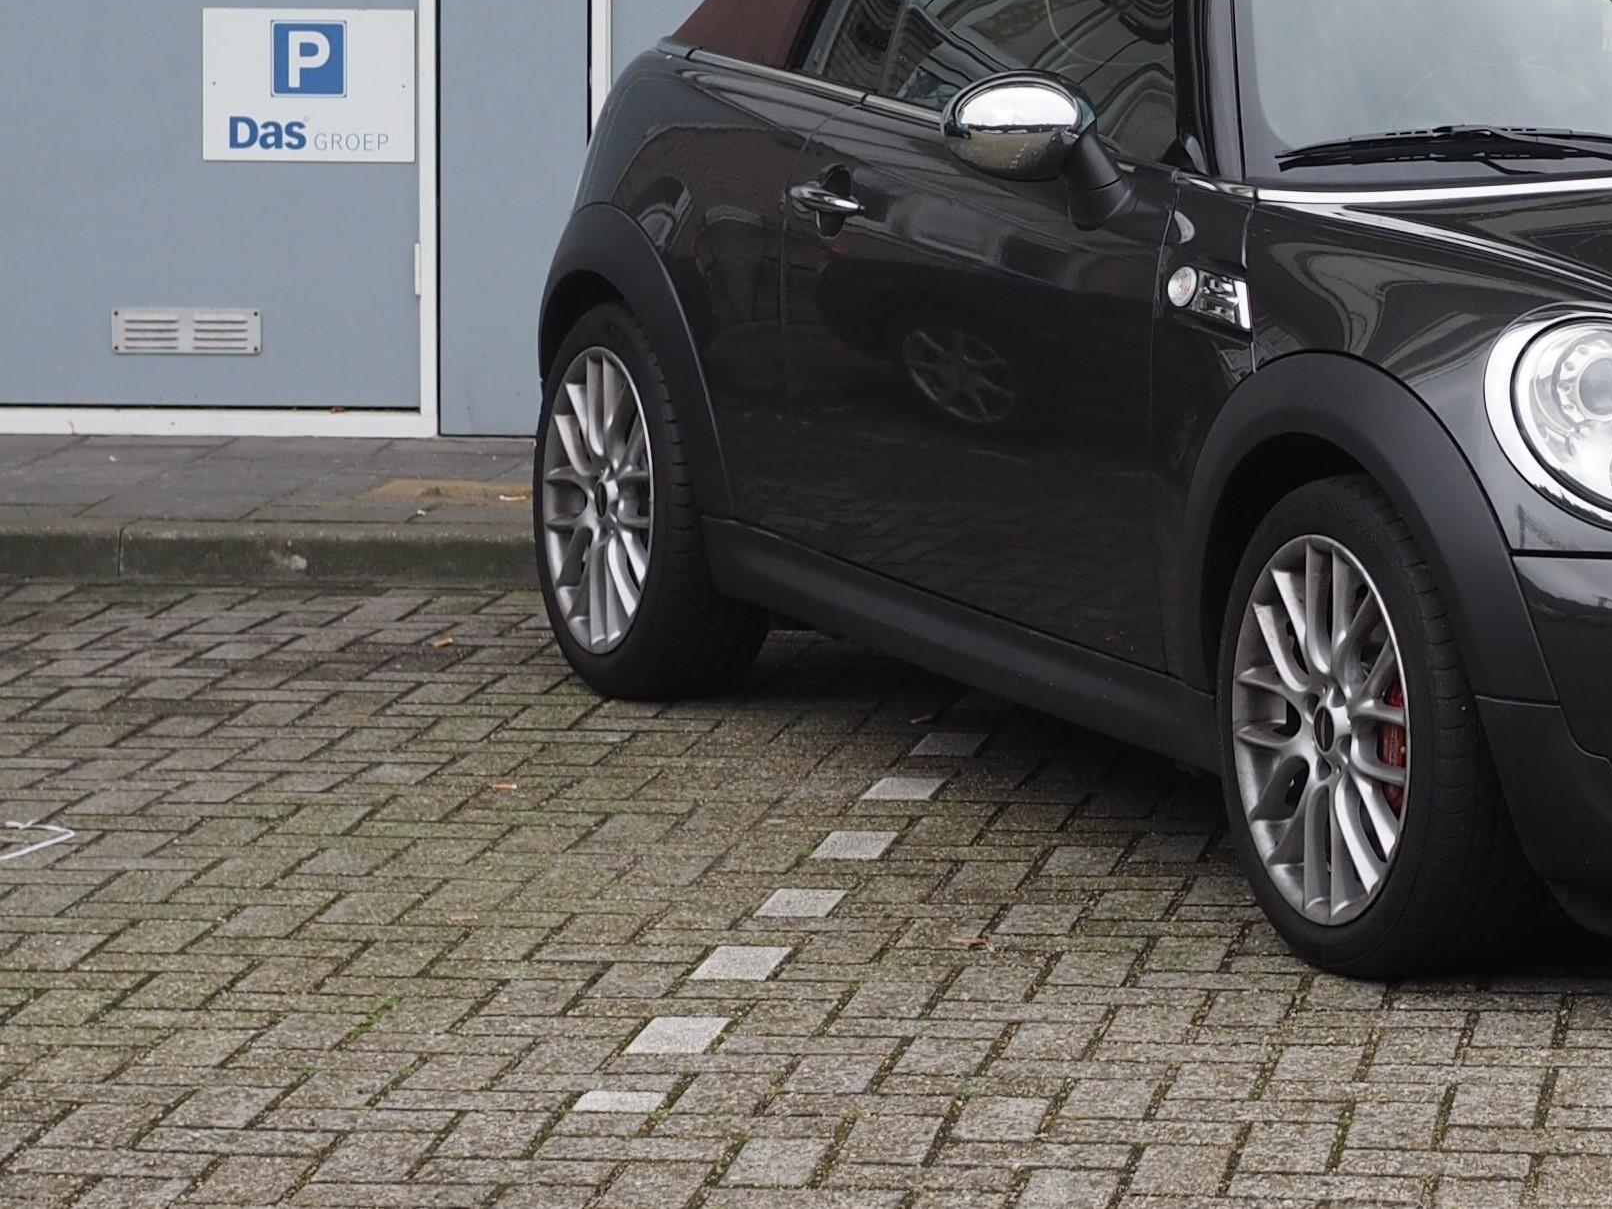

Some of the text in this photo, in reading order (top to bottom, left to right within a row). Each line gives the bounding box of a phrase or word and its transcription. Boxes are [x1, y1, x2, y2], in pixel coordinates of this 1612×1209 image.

[288, 31, 330, 88] P
[229, 116, 389, 151] Das GROEP
